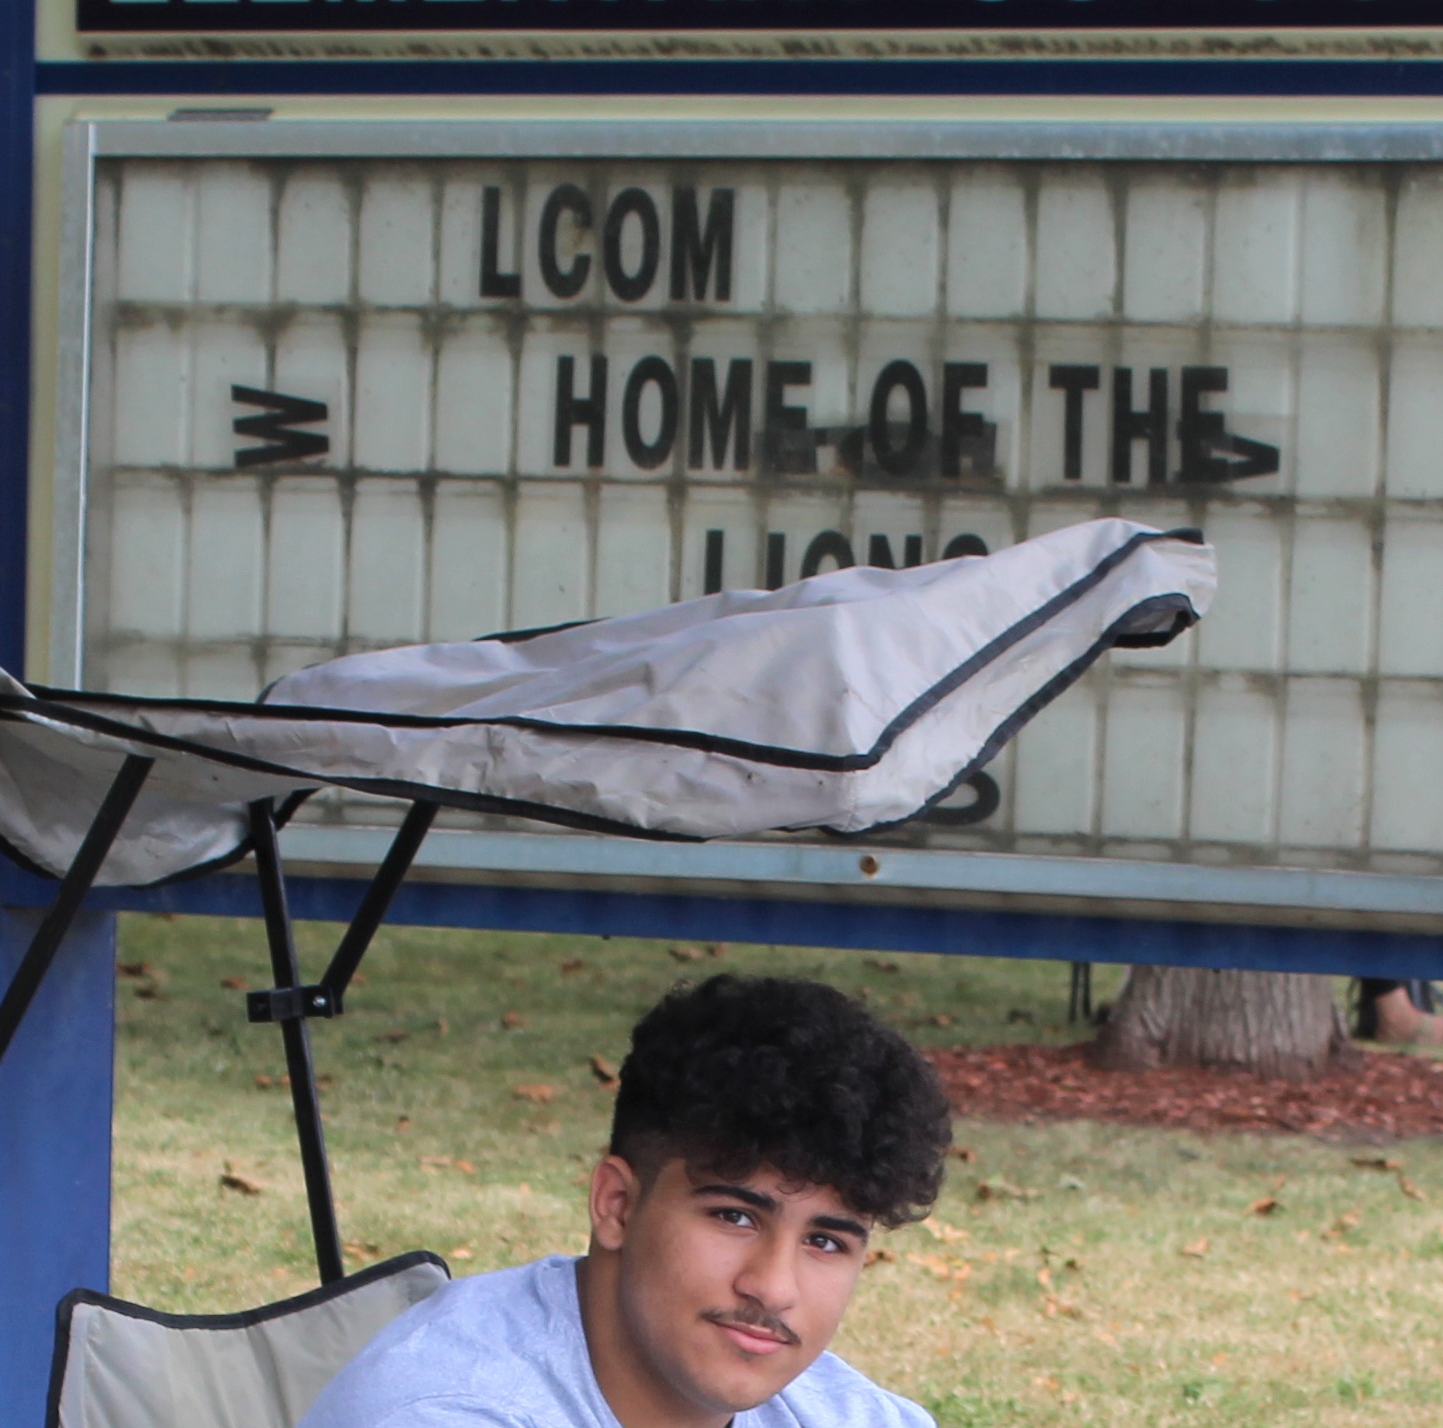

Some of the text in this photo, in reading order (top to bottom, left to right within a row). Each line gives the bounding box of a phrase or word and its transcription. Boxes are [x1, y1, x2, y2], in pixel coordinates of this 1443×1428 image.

[479, 184, 735, 301] LCOM
[553, 354, 1229, 484] HOME OF THE
